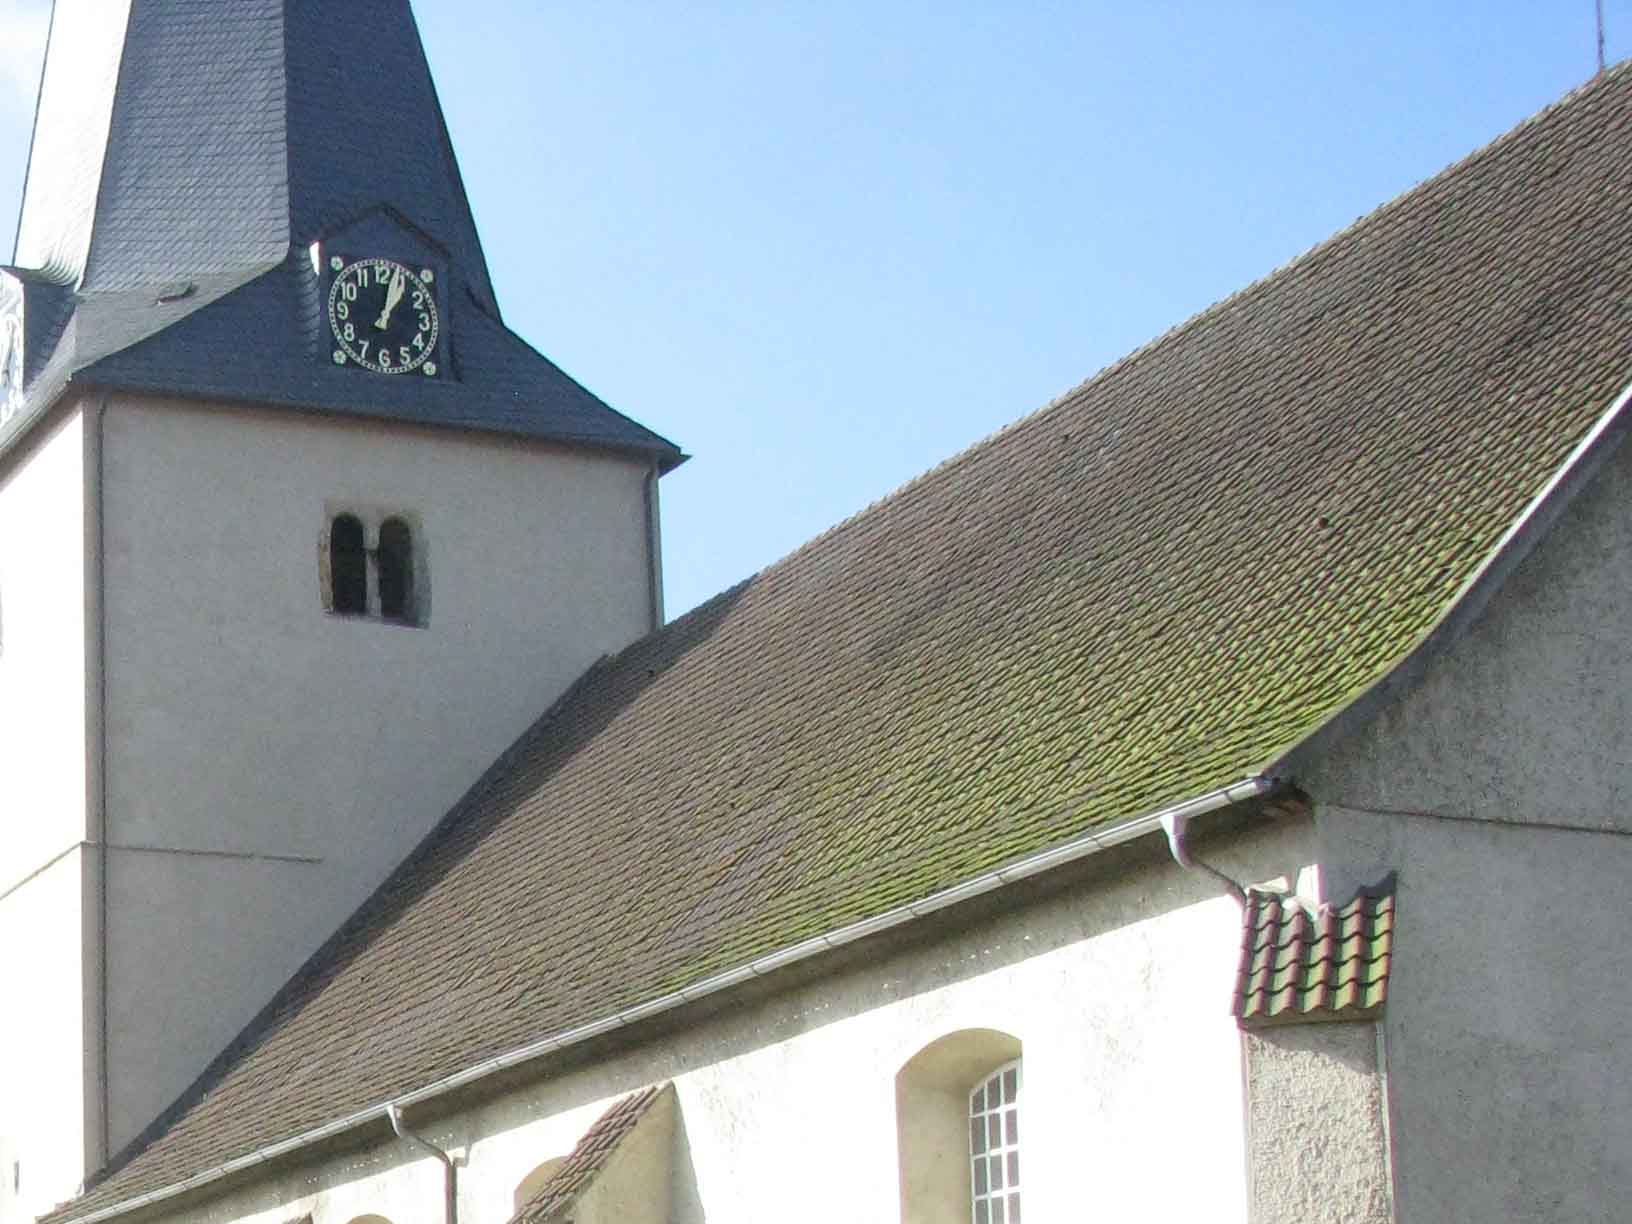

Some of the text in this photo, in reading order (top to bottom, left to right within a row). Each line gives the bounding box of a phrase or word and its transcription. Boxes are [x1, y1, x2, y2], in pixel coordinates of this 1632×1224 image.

[357, 268, 368, 288] 11
[375, 266, 390, 284] 12
[341, 282, 357, 301] 10
[412, 291, 423, 310] 2
[337, 301, 349, 320] 9
[418, 313, 430, 332] 3
[343, 323, 355, 342] 8
[412, 332, 425, 351] 4
[358, 339, 370, 359] 7
[378, 348, 391, 367] 6
[399, 346, 410, 365] 5
